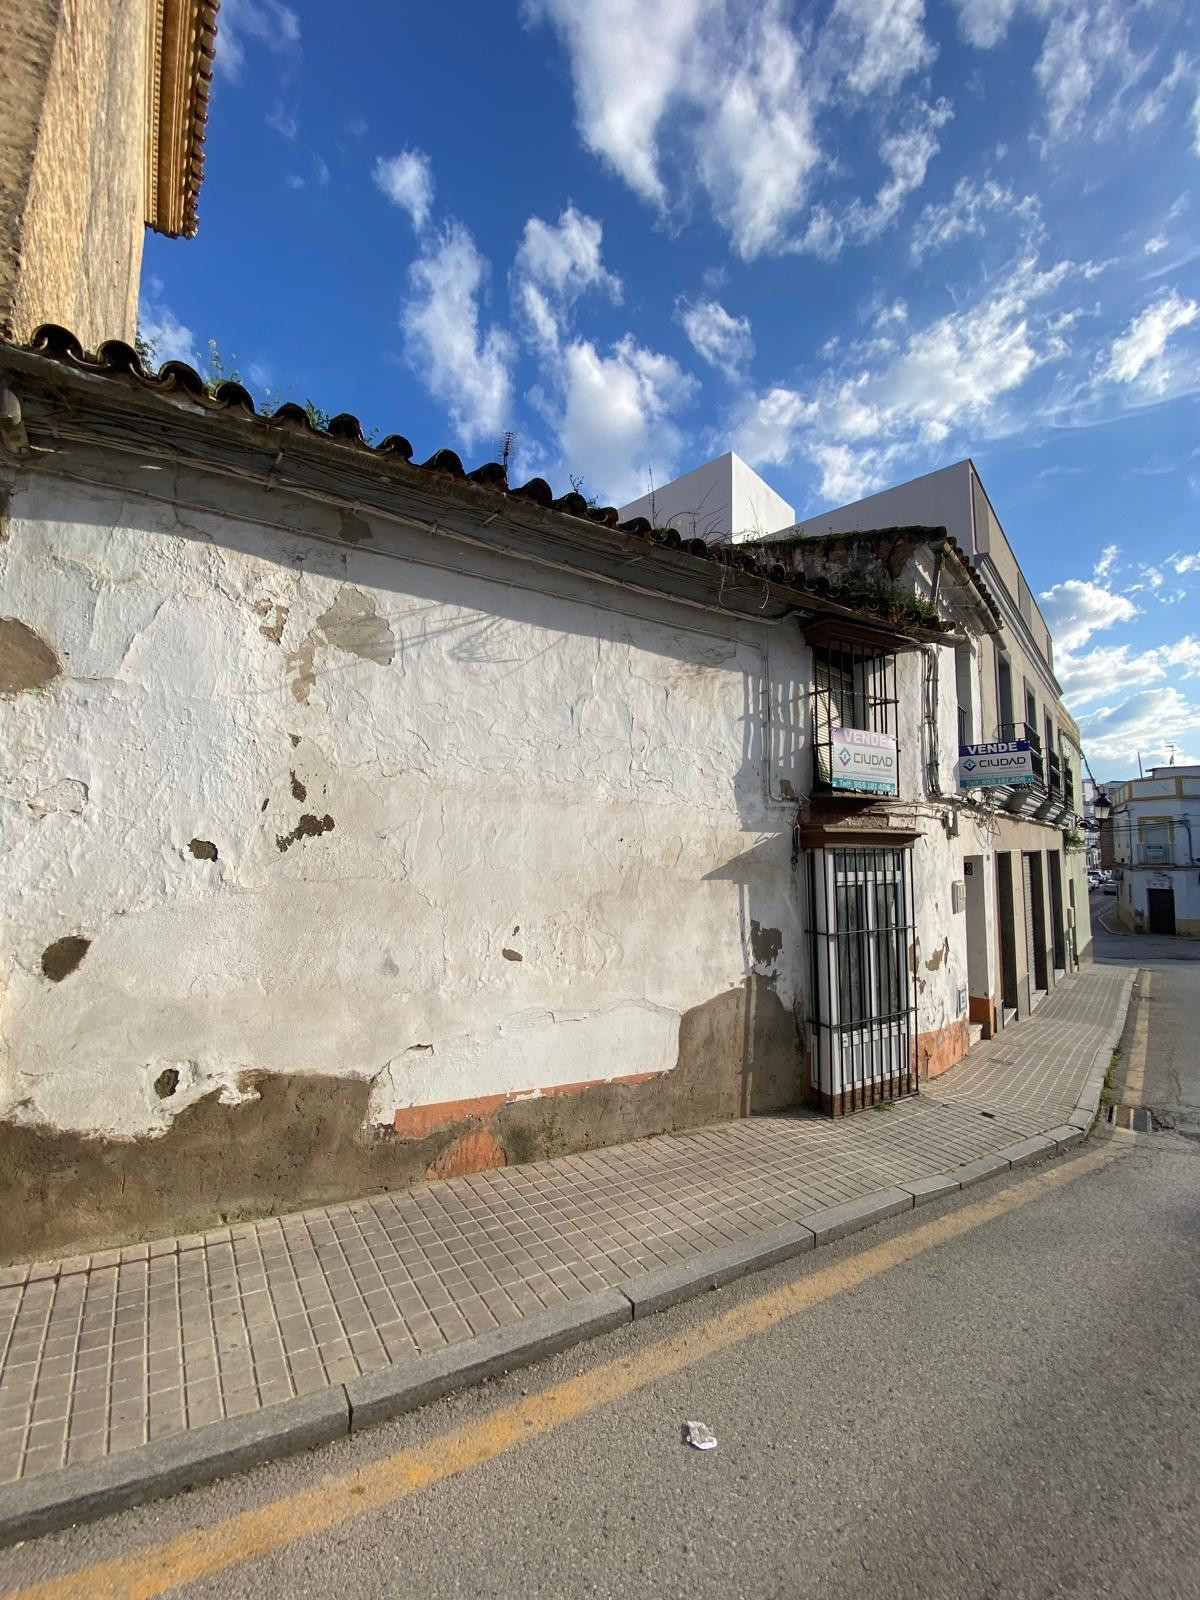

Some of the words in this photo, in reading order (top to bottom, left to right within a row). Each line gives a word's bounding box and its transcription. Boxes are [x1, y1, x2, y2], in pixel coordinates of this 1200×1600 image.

[844, 730, 887, 747] VENDE
[967, 742, 1018, 755] VENDE
[853, 753, 893, 767] CIUDAD
[979, 757, 1026, 767] CIUDAD
